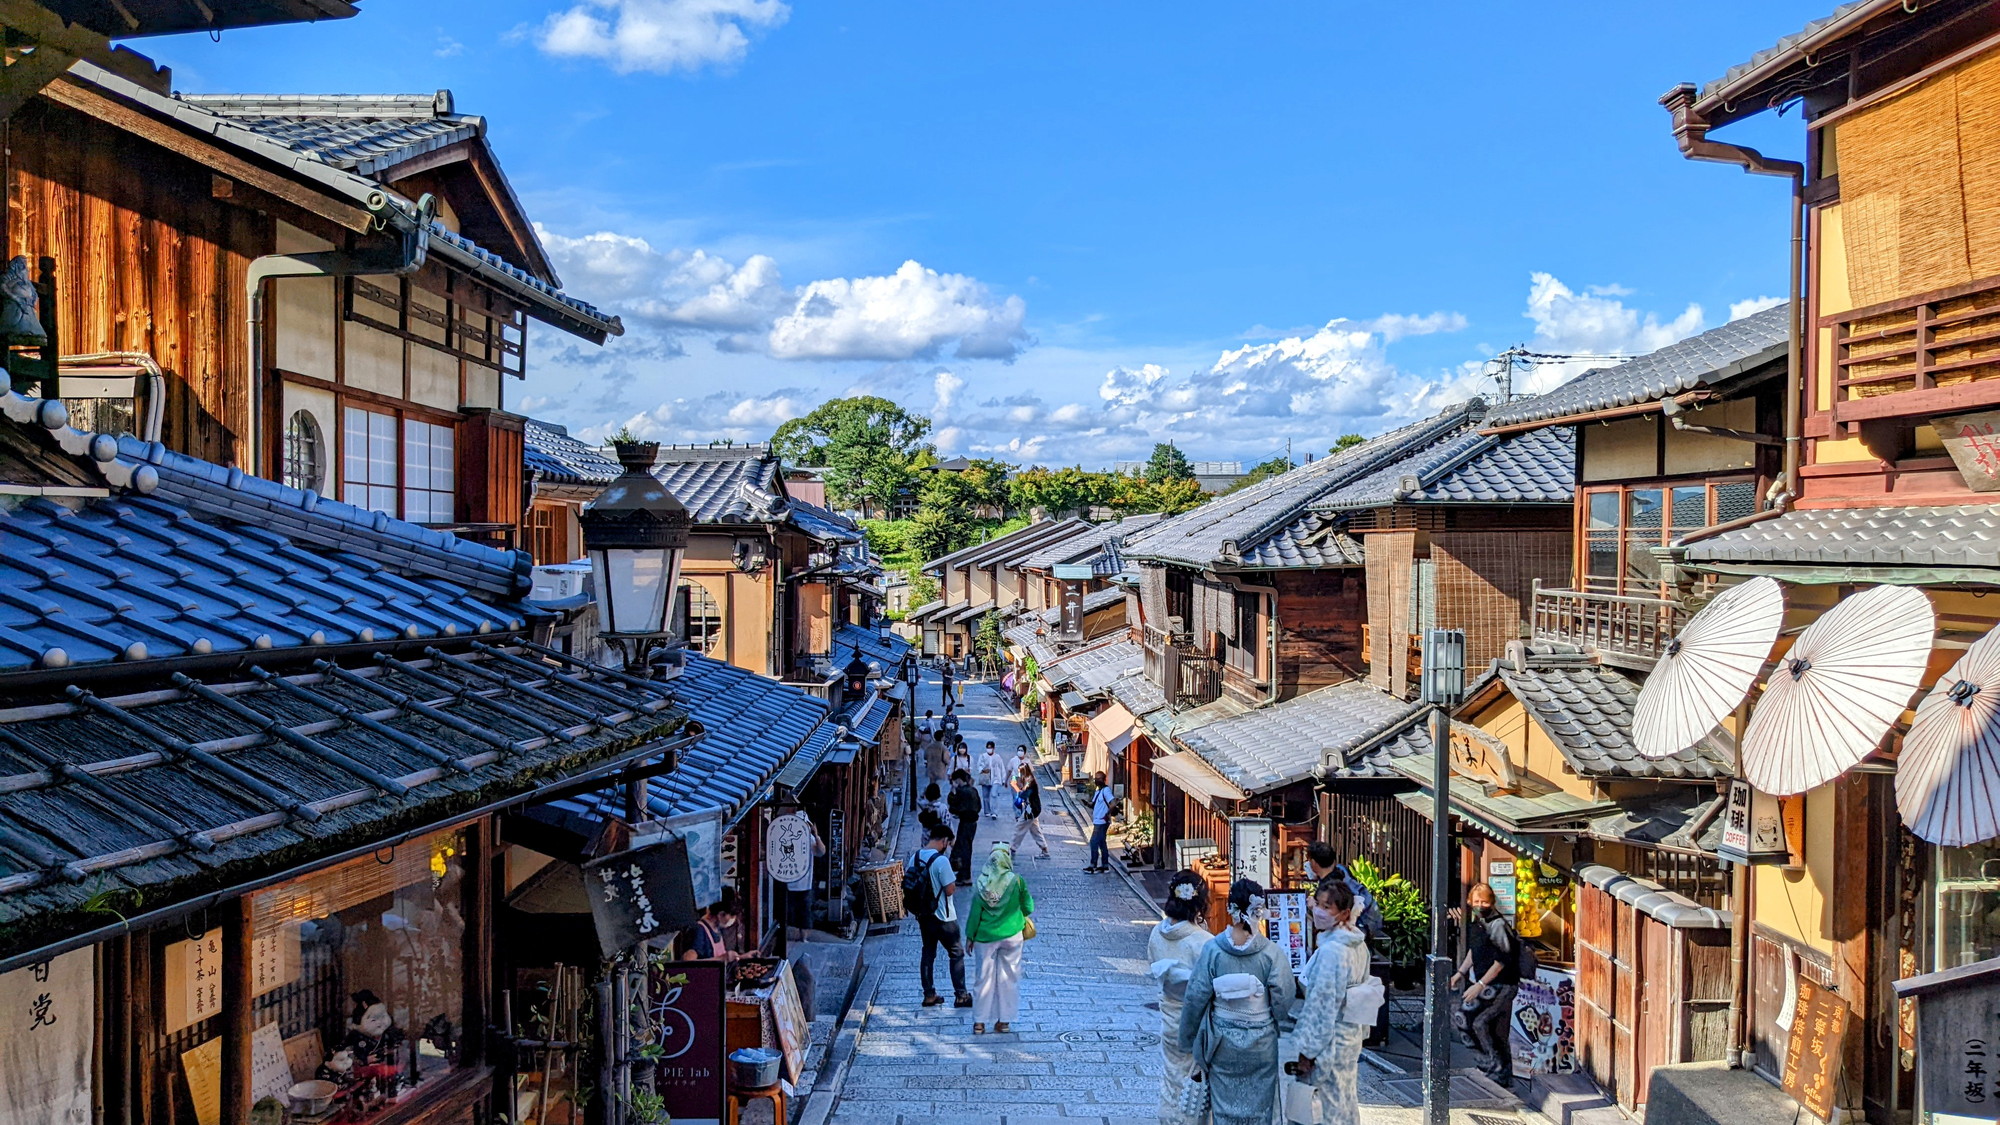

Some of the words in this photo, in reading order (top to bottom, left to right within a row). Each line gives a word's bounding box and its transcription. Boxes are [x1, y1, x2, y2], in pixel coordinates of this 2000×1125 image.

[1730, 786, 1747, 831] 珈琲
[1259, 828, 1268, 857] そば処
[1725, 831, 1746, 846] COFFEE
[1810, 1001, 1830, 1058] 二寧坂
[1830, 1004, 1844, 1034] 京都
[1783, 983, 1812, 1089] 珈琲焙煎工房
[664, 1067, 684, 1078] PIE
[690, 1066, 710, 1078] lab
[1803, 1083, 1823, 1104] Coffee
[1804, 1094, 1827, 1118] Roaster
